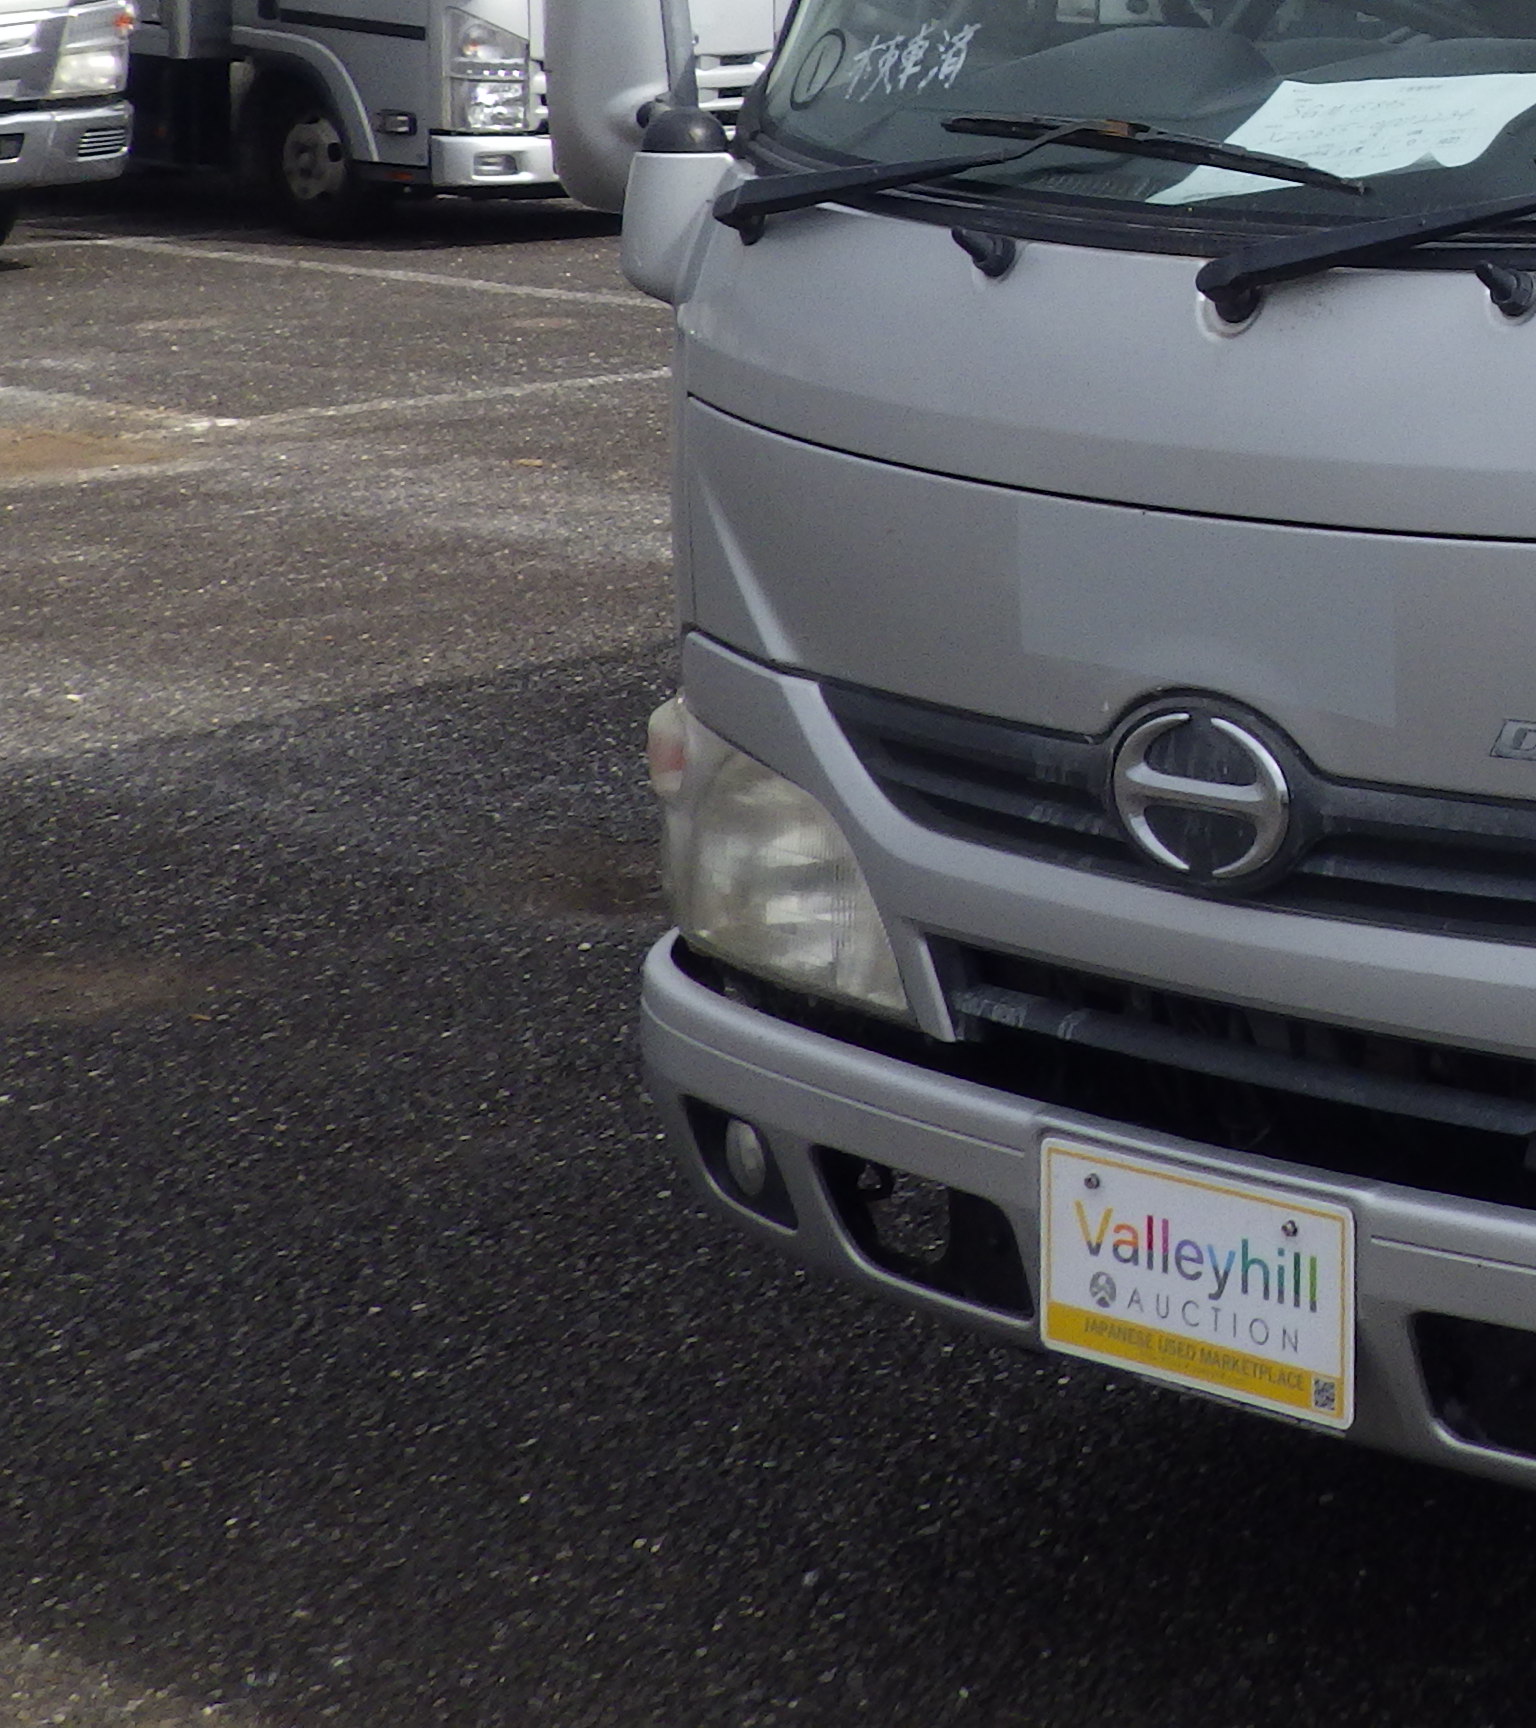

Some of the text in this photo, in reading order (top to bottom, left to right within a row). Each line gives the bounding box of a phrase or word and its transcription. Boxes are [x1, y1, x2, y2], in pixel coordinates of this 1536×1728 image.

[1074, 1200, 1318, 1313] Valleyhill
[1084, 1317, 1152, 1350] JAPANESE
[1157, 1336, 1197, 1362] USED
[1199, 1347, 1306, 1392] MARKETPLACE
[1127, 1287, 1299, 1354] AUCTION
